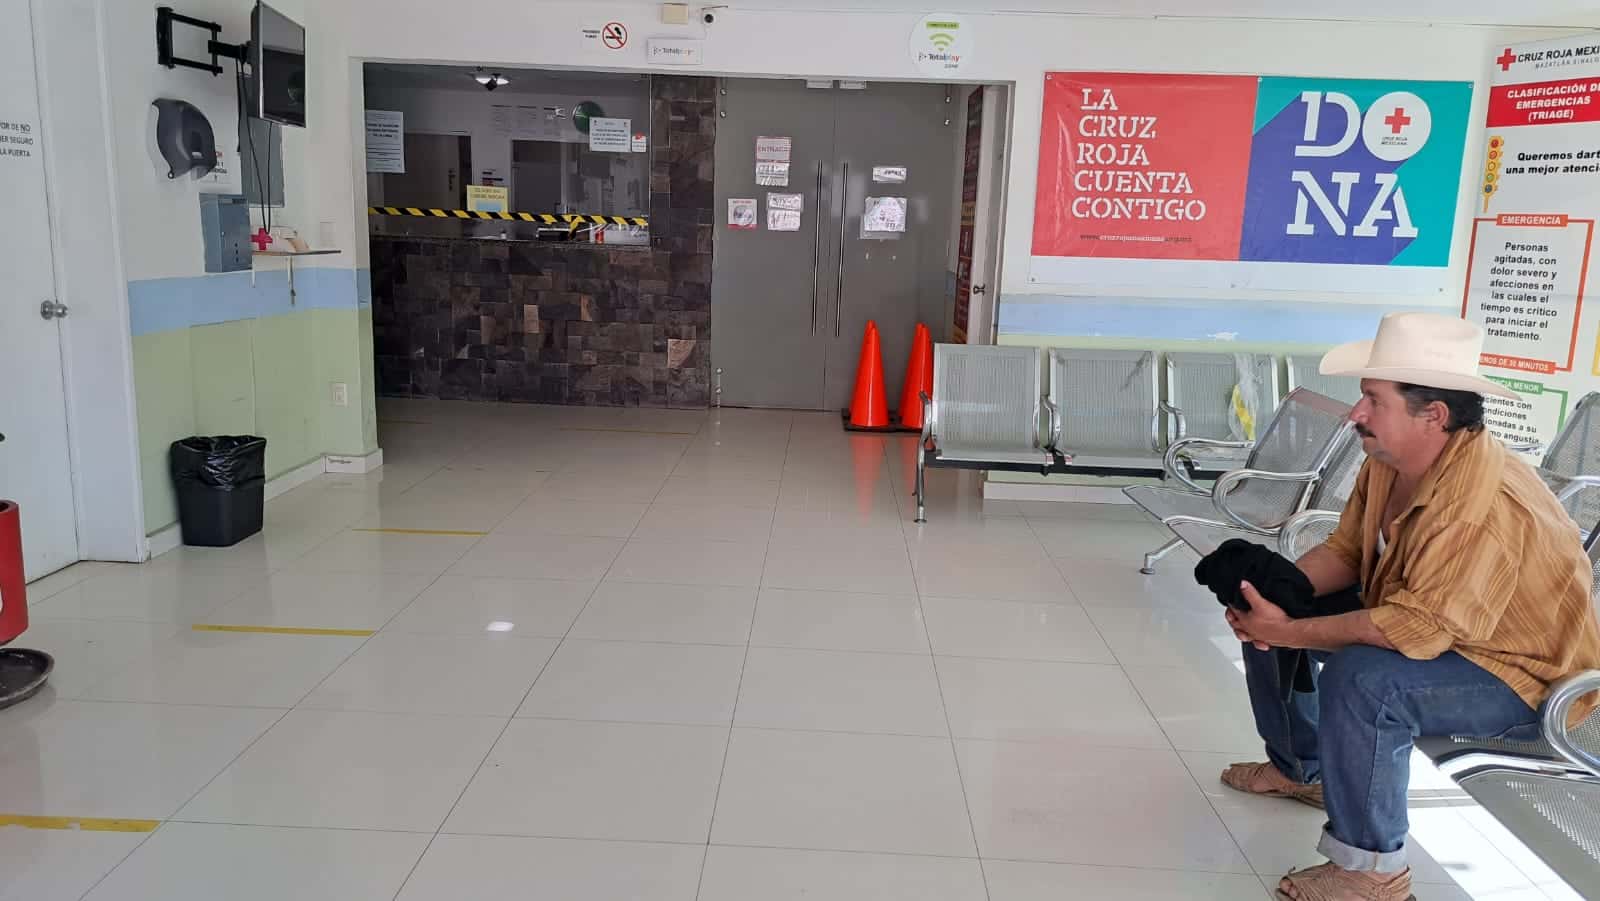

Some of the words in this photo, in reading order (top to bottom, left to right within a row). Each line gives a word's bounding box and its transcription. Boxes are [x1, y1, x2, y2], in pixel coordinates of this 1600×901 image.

[1518, 52, 1544, 63] CRUZ
[1546, 48, 1573, 60] ROJA
[1507, 83, 1587, 99] CLASIFICACIÓN
[1081, 88, 1118, 110] LA
[1516, 96, 1591, 110] EMERGENCIAS
[1528, 109, 1574, 122] (TRIAGE)
[1079, 115, 1157, 139] CRUZ
[1076, 142, 1150, 166] ROJA
[1517, 151, 1573, 161] Queremos
[1506, 166, 1525, 174] una
[1528, 164, 1560, 176] mejor
[1562, 162, 1600, 173] atenci
[1073, 169, 1193, 194] CUENTA
[1071, 197, 1207, 221] CONTIGO
[1286, 171, 1419, 238] NA
[1502, 215, 1561, 225] EMERGENCIA
[1505, 241, 1549, 252] Personas
[1494, 255, 1535, 265] agitadas,
[1538, 257, 1557, 265] con
[1490, 266, 1514, 276] dolor
[1516, 269, 1549, 278] severo
[1551, 270, 1557, 280] y
[1490, 279, 1539, 290] afecciones
[1542, 283, 1554, 291] en
[1491, 291, 1504, 300] las
[1507, 293, 1537, 302] cuales
[1540, 295, 1549, 303] el
[1480, 303, 1511, 313] tiempo
[1513, 306, 1524, 314] es
[1485, 316, 1505, 325] para
[1508, 317, 1537, 328] iniciar
[1540, 320, 1548, 328] el
[1487, 327, 1542, 341] tratamiento.
[1518, 360, 1548, 370] MINUTOS
[1513, 382, 1540, 392] MENOR
[1504, 433, 1539, 444] angustia
